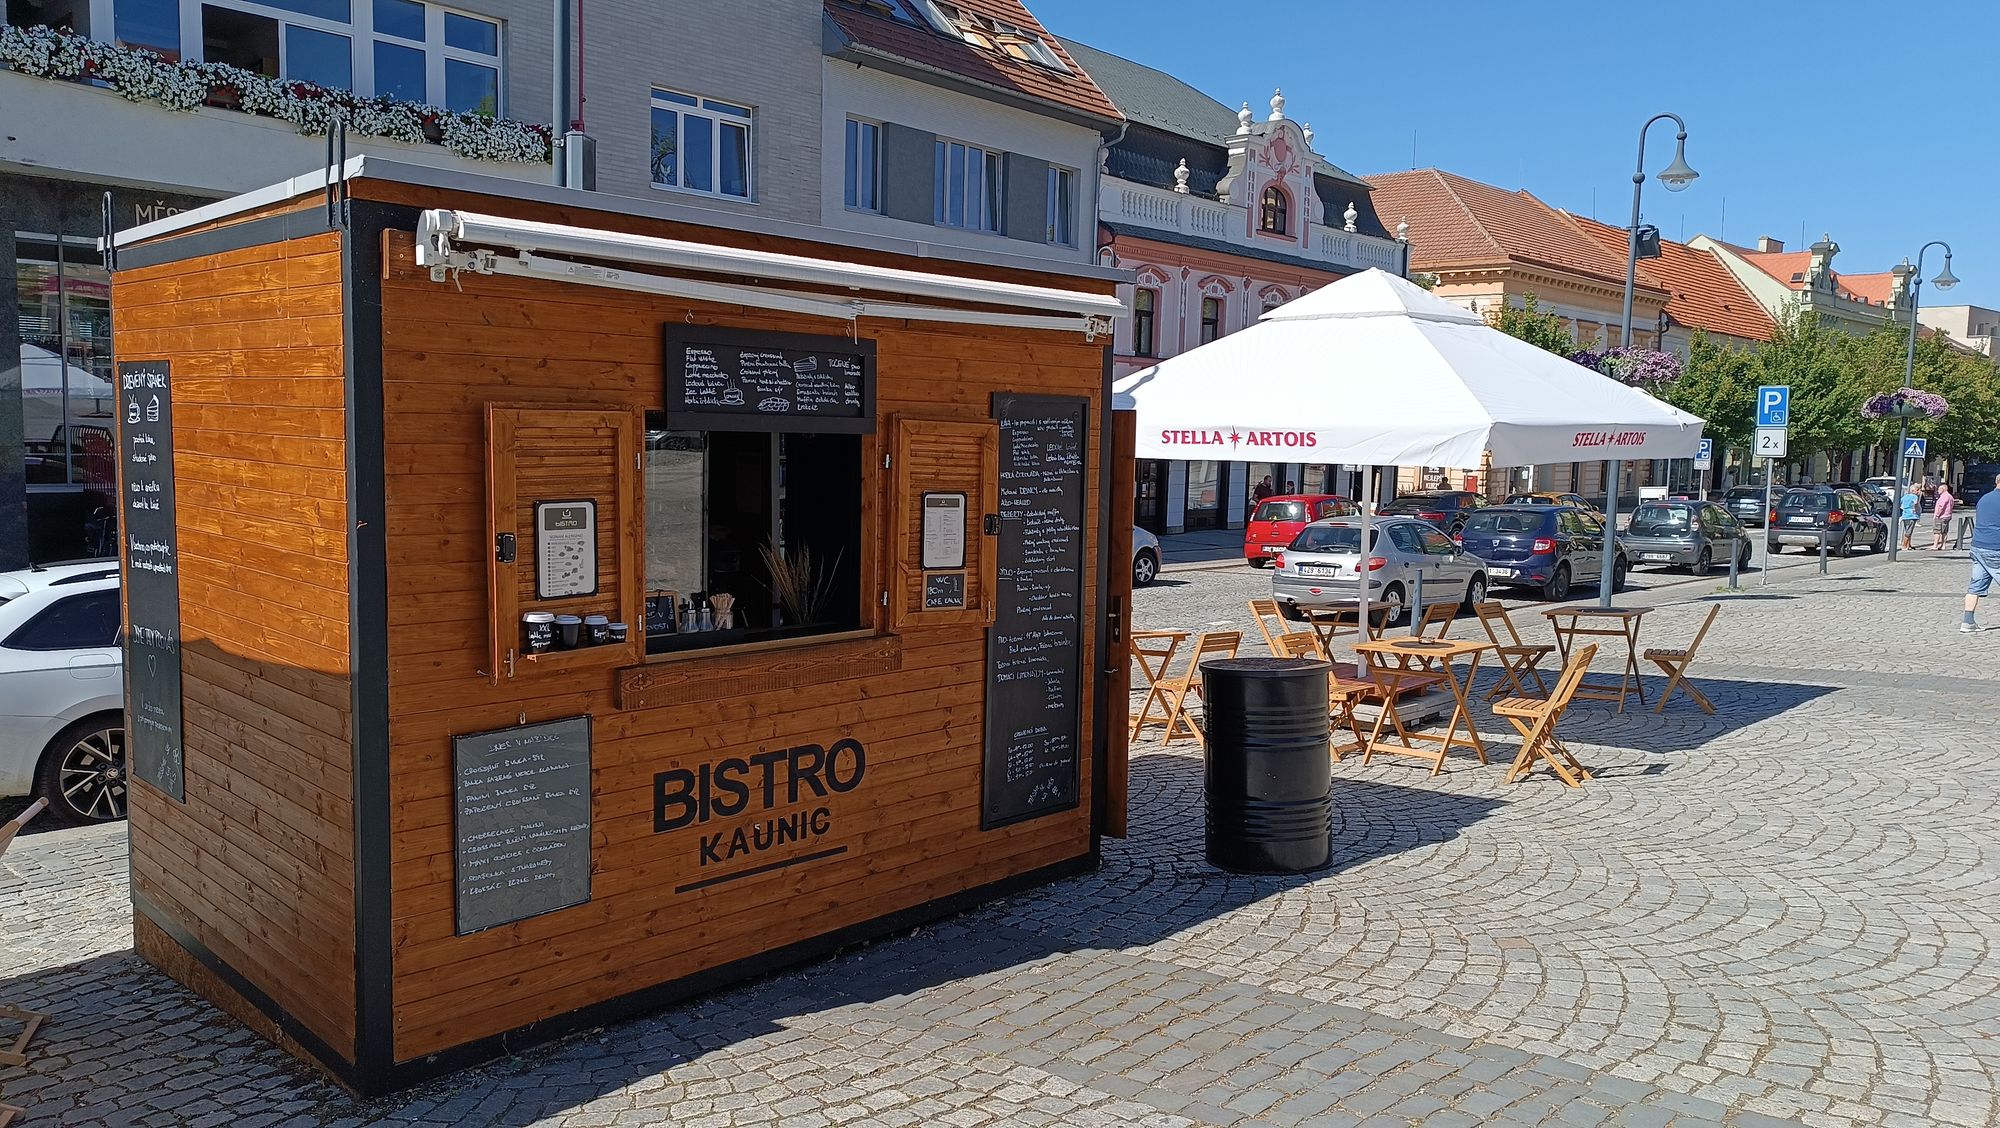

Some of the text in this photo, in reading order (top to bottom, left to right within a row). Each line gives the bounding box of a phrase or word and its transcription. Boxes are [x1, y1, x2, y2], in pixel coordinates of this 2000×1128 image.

[1764, 391, 1782, 416] P
[1161, 429, 1318, 448] STELLA ARTOIS
[1572, 431, 1647, 448] STELLA ARTOIS
[1762, 436, 1779, 449] 2 x
[935, 576, 951, 585] WC
[653, 737, 866, 834] BISTRO
[699, 806, 832, 867] KAUNIC
